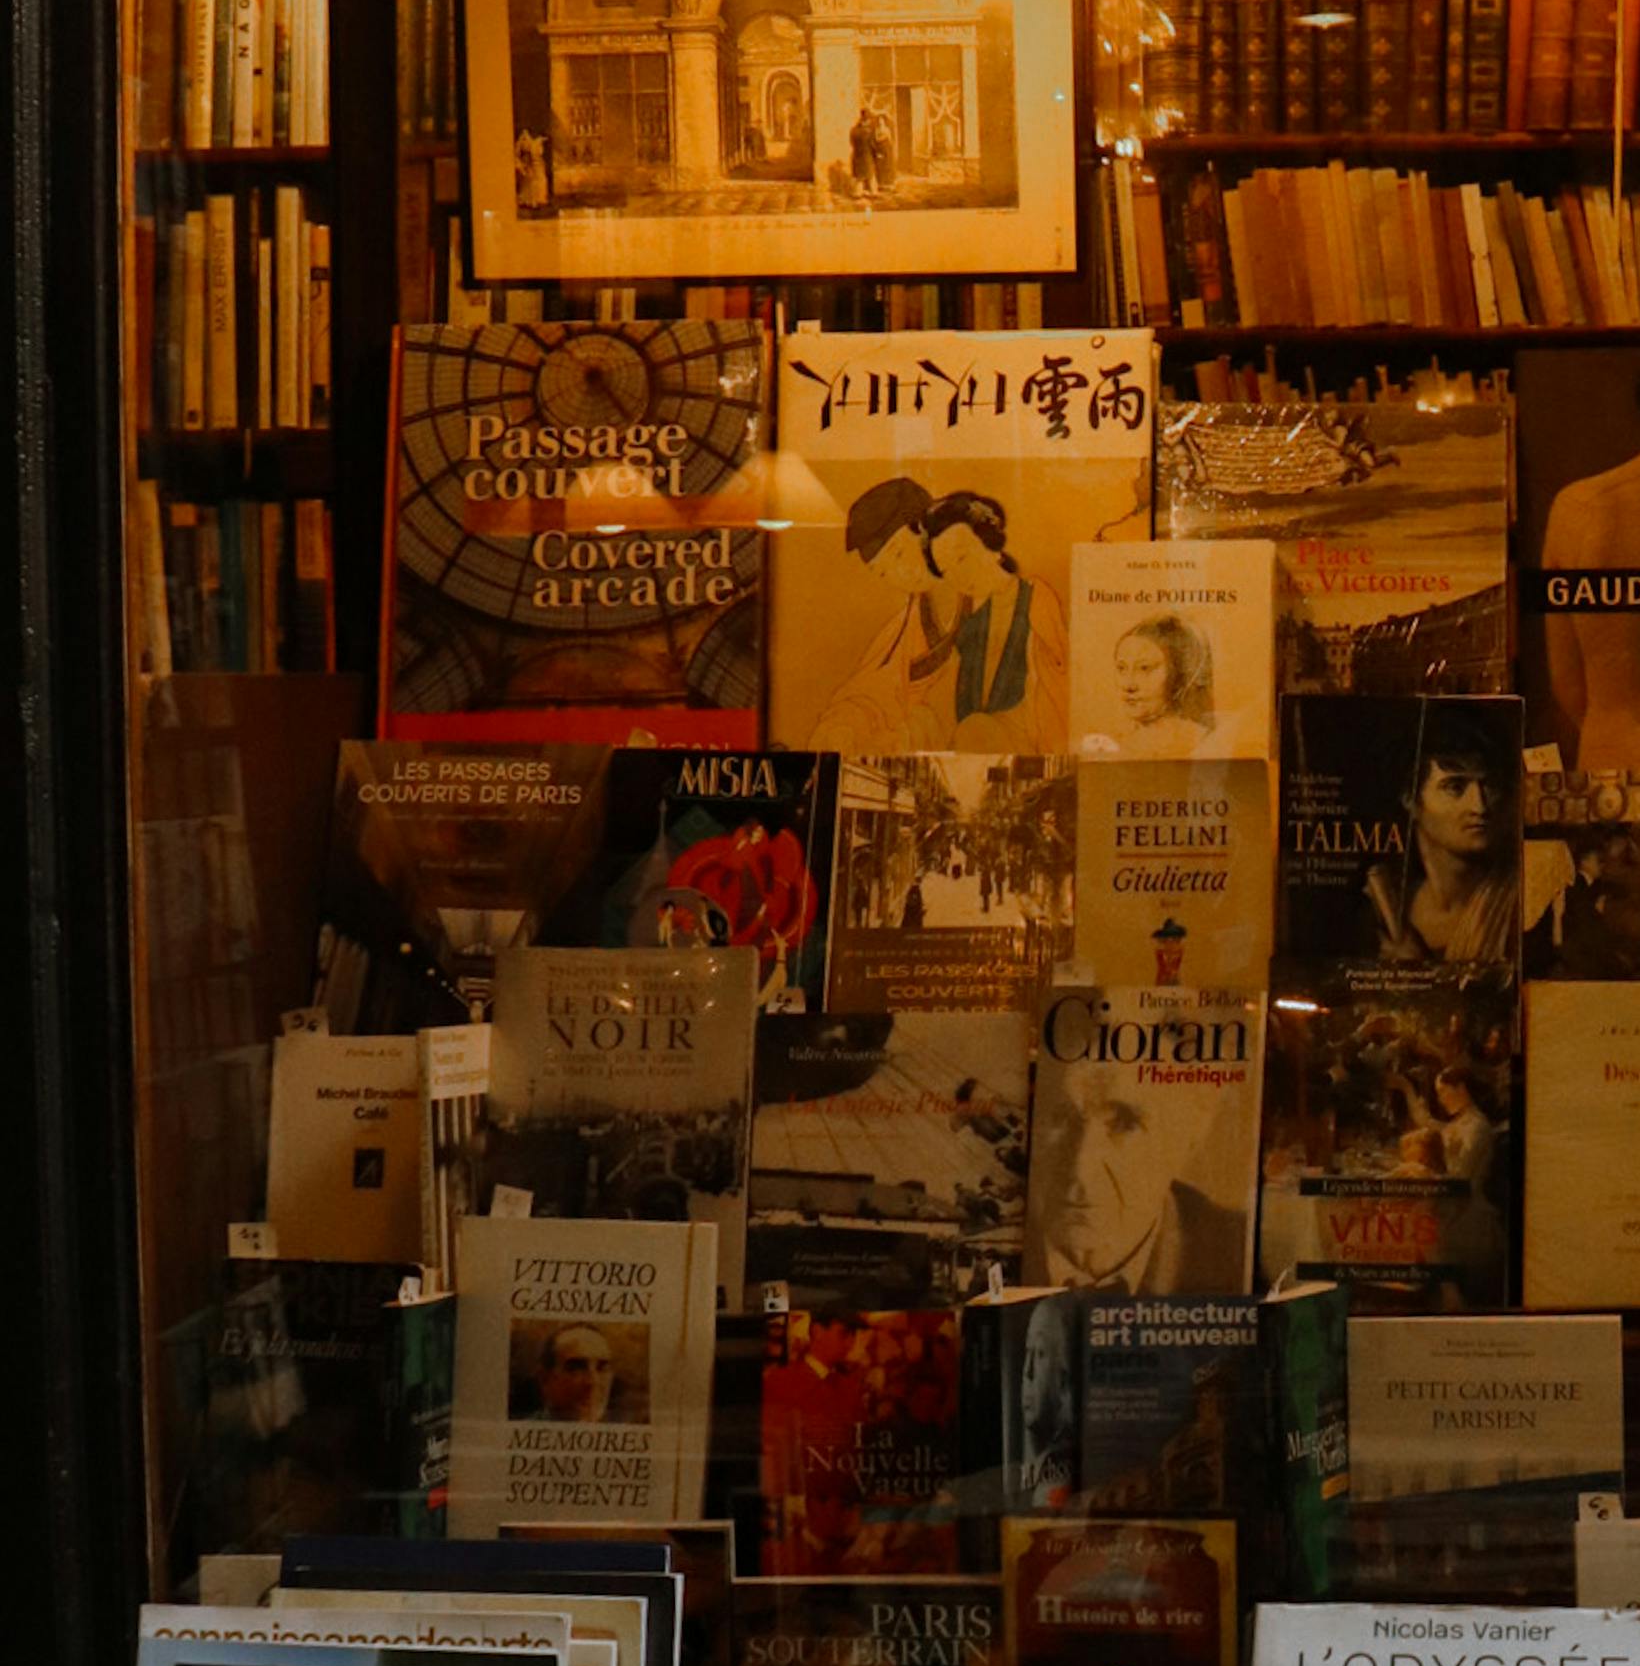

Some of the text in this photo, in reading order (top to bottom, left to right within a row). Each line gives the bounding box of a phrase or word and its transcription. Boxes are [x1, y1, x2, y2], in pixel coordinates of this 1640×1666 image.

[464, 415, 689, 465] Passage
[463, 454, 688, 501] couvert
[531, 529, 734, 573] Covered
[1297, 540, 1374, 567] Place
[531, 565, 739, 608] arcade
[1319, 565, 1452, 595] Victoires
[1088, 589, 1238, 604] Diane de POITIERS
[393, 762, 553, 783] LES PASSAGES
[676, 756, 779, 799] MISIA
[357, 782, 583, 806] COUVERTS DE PARIS
[1115, 799, 1230, 818] FEDERICO
[1115, 825, 1229, 848] FELLINI
[1287, 821, 1405, 854] TALMA
[1112, 865, 1230, 894] Giulietta
[864, 962, 1040, 981] LES PASSAGES
[547, 995, 577, 1016] LE
[887, 983, 1016, 1001] COUVERTS
[1138, 990, 1194, 1009] Patrice
[547, 1017, 696, 1051] NOIR
[1043, 994, 1251, 1066] Cioran
[1137, 1064, 1247, 1090] l'hérétique
[316, 1085, 362, 1101] Michel
[353, 1106, 389, 1122] Café
[512, 1258, 657, 1288] VITTORIO
[510, 1289, 654, 1316] GASSMAN
[1089, 1325, 1258, 1347] art nouveau
[1386, 1380, 1583, 1404] PETIT CADASTRE
[1432, 1409, 1537, 1431] PARISIEN
[853, 1422, 896, 1451] La
[506, 1456, 653, 1481] DANS UNE
[805, 1444, 951, 1476] Nouvelle
[505, 1481, 651, 1508] SOUPENTE
[870, 1603, 993, 1639] PARIS
[1037, 1595, 1205, 1627] Histoire de rire
[1373, 1618, 1557, 1642] Nicolas Vanier
